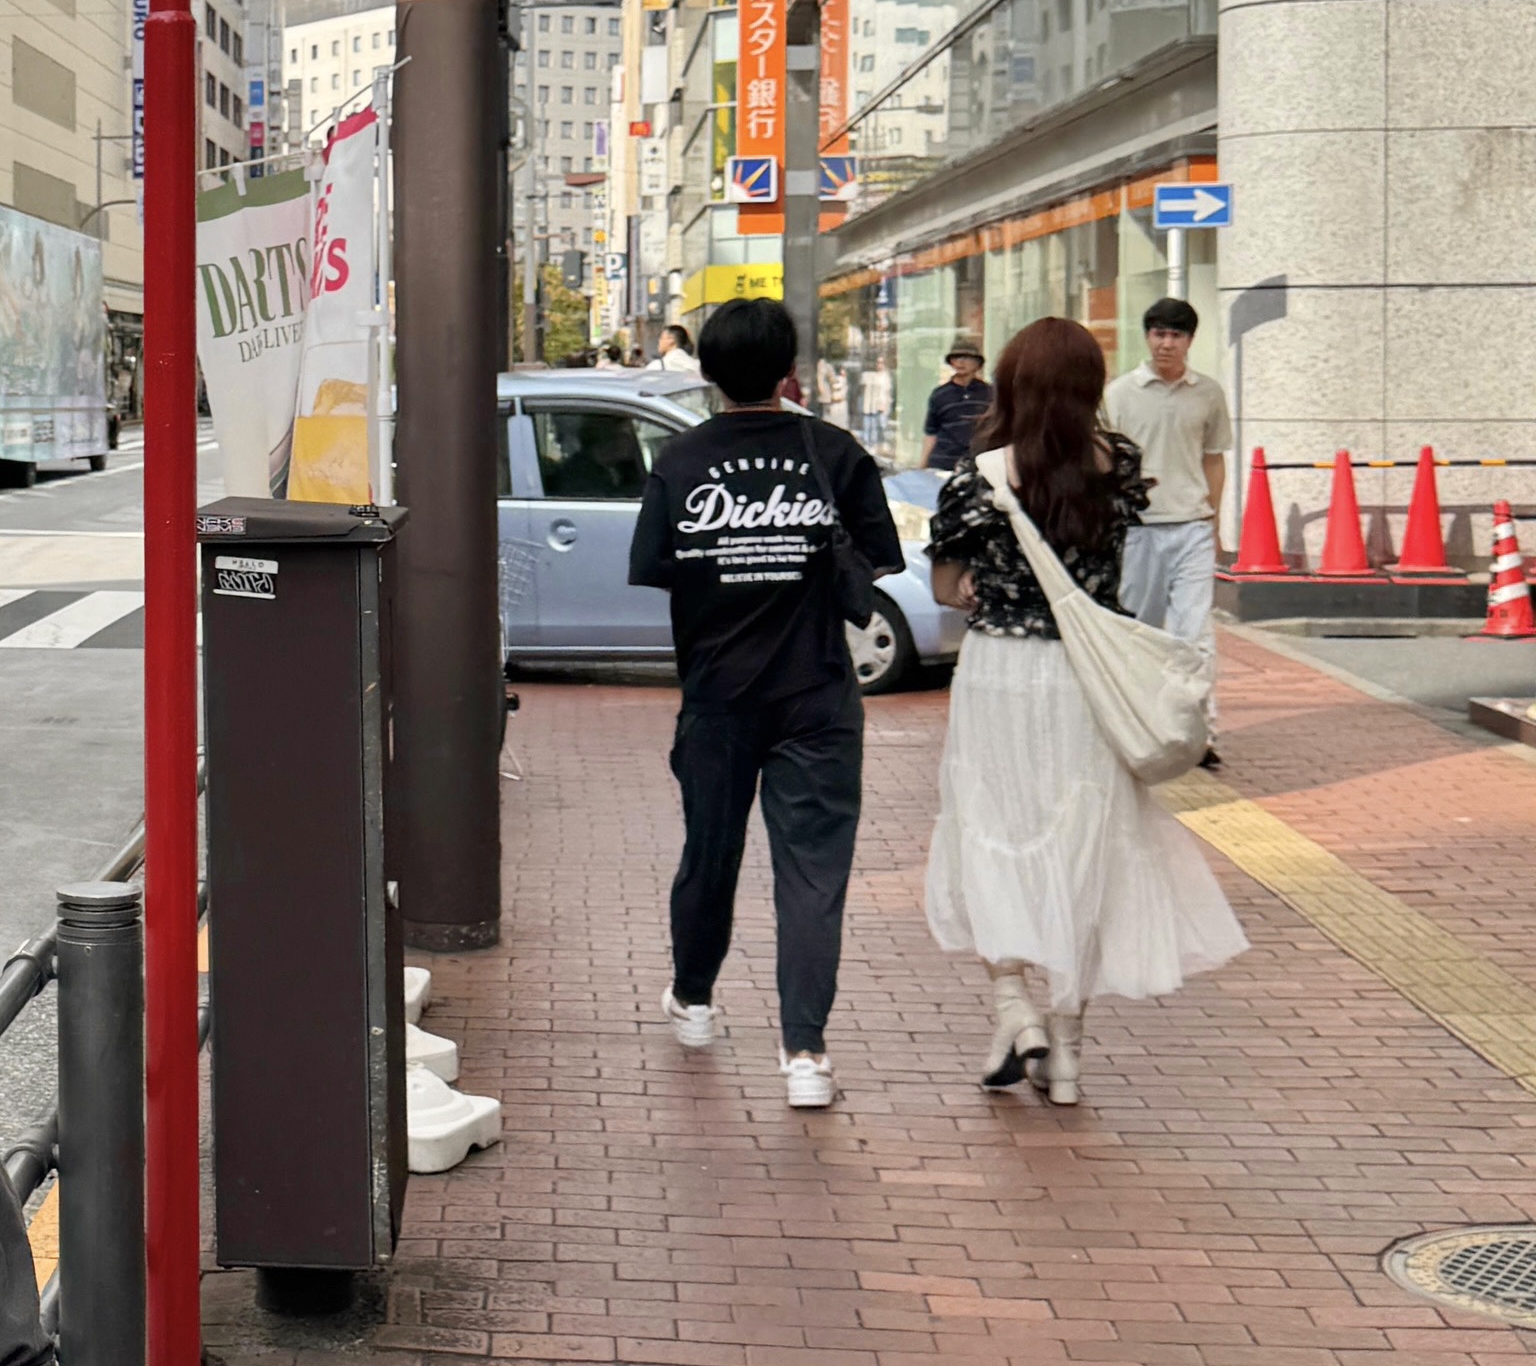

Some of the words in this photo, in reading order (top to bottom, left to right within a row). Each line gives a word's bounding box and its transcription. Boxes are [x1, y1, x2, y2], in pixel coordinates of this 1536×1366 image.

[197, 236, 310, 339] DARTS
[708, 457, 810, 479] GENUINE
[677, 483, 838, 534] Dickies
